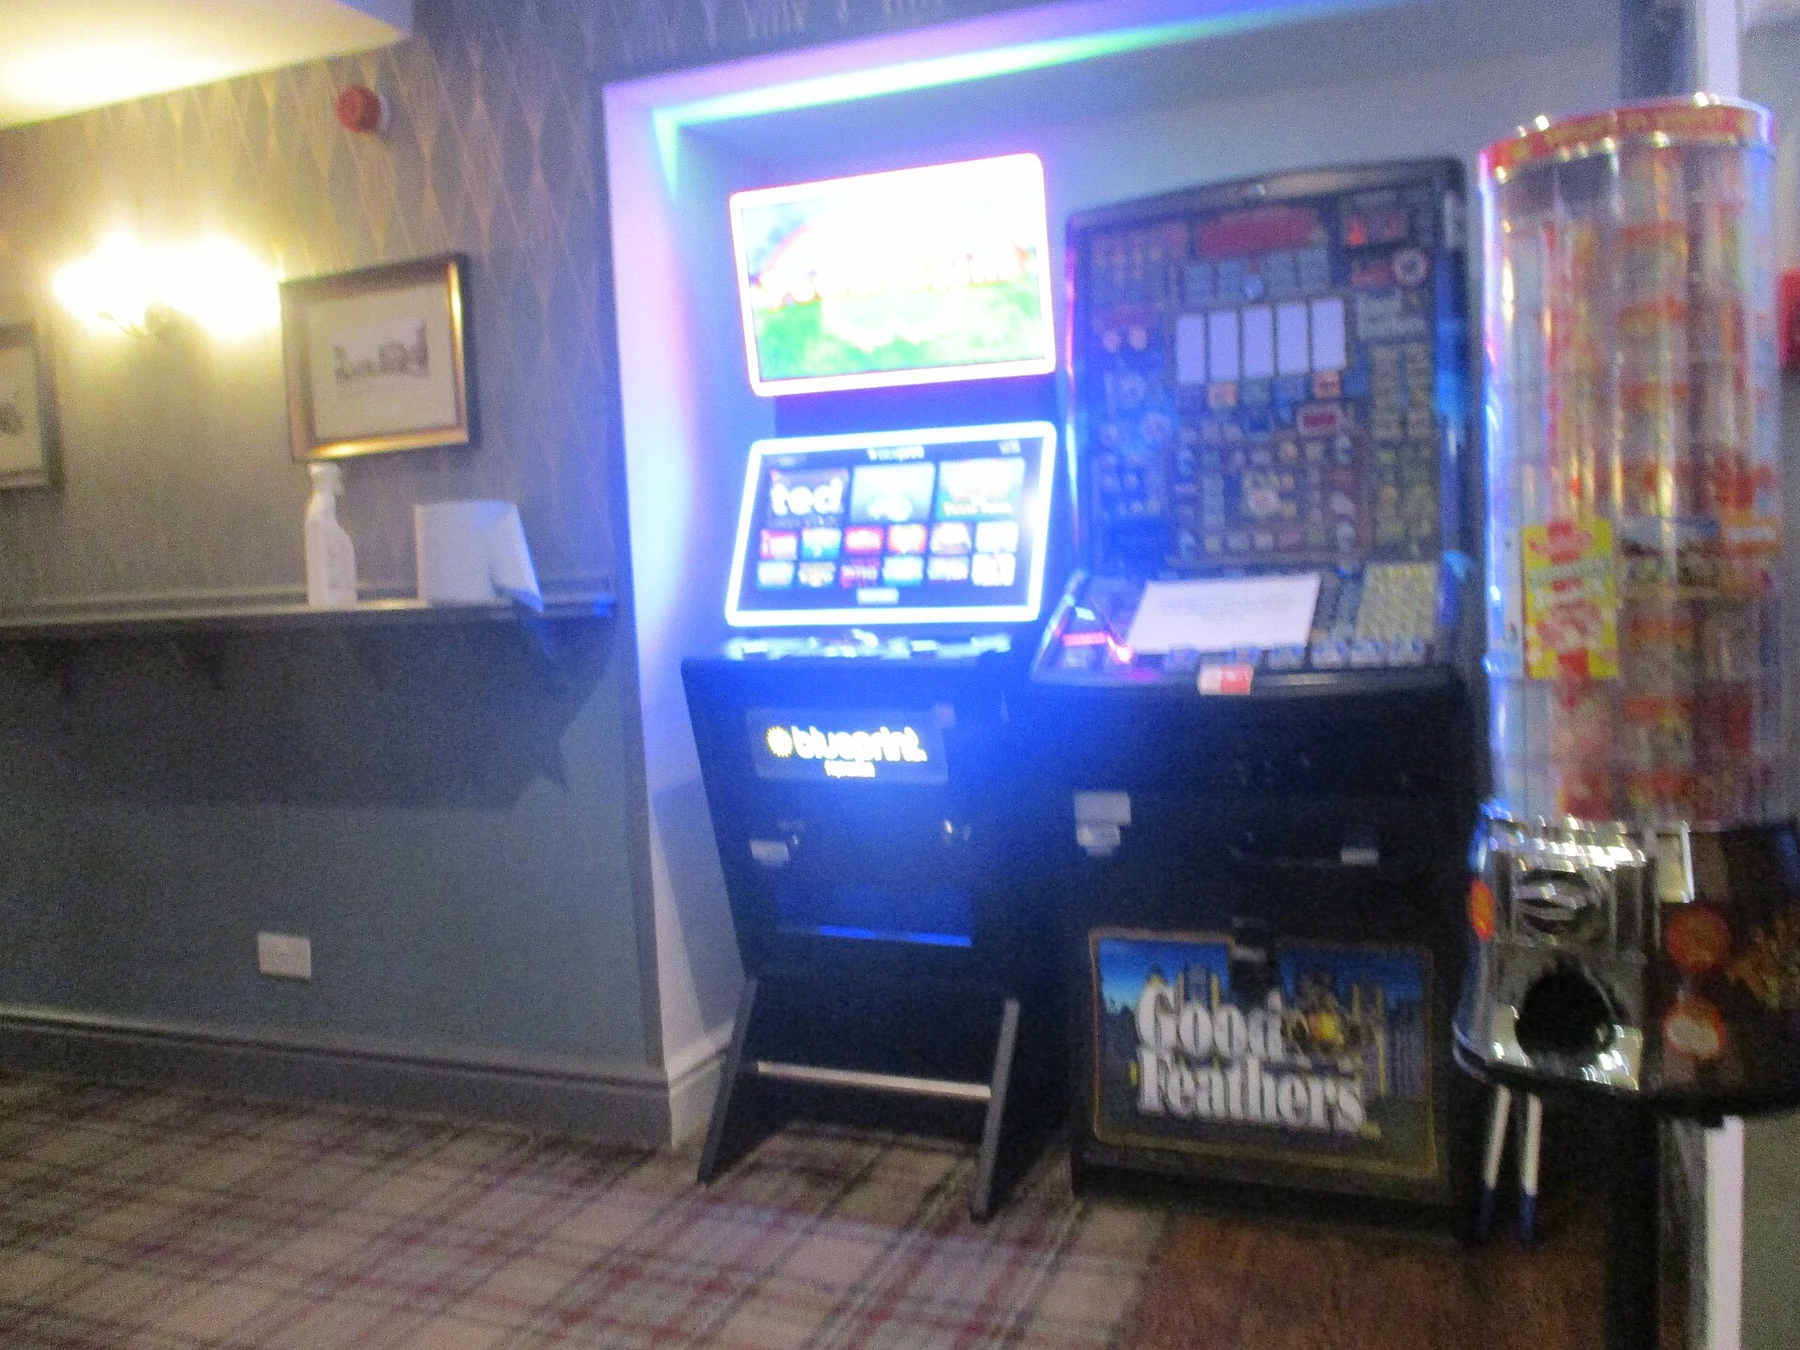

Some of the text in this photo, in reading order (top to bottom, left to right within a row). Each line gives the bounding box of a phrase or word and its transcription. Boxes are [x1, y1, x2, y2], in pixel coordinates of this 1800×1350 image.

[770, 477, 844, 517] ted
[1137, 982, 1286, 1063] Good
[1138, 1046, 1368, 1134] Feathers
